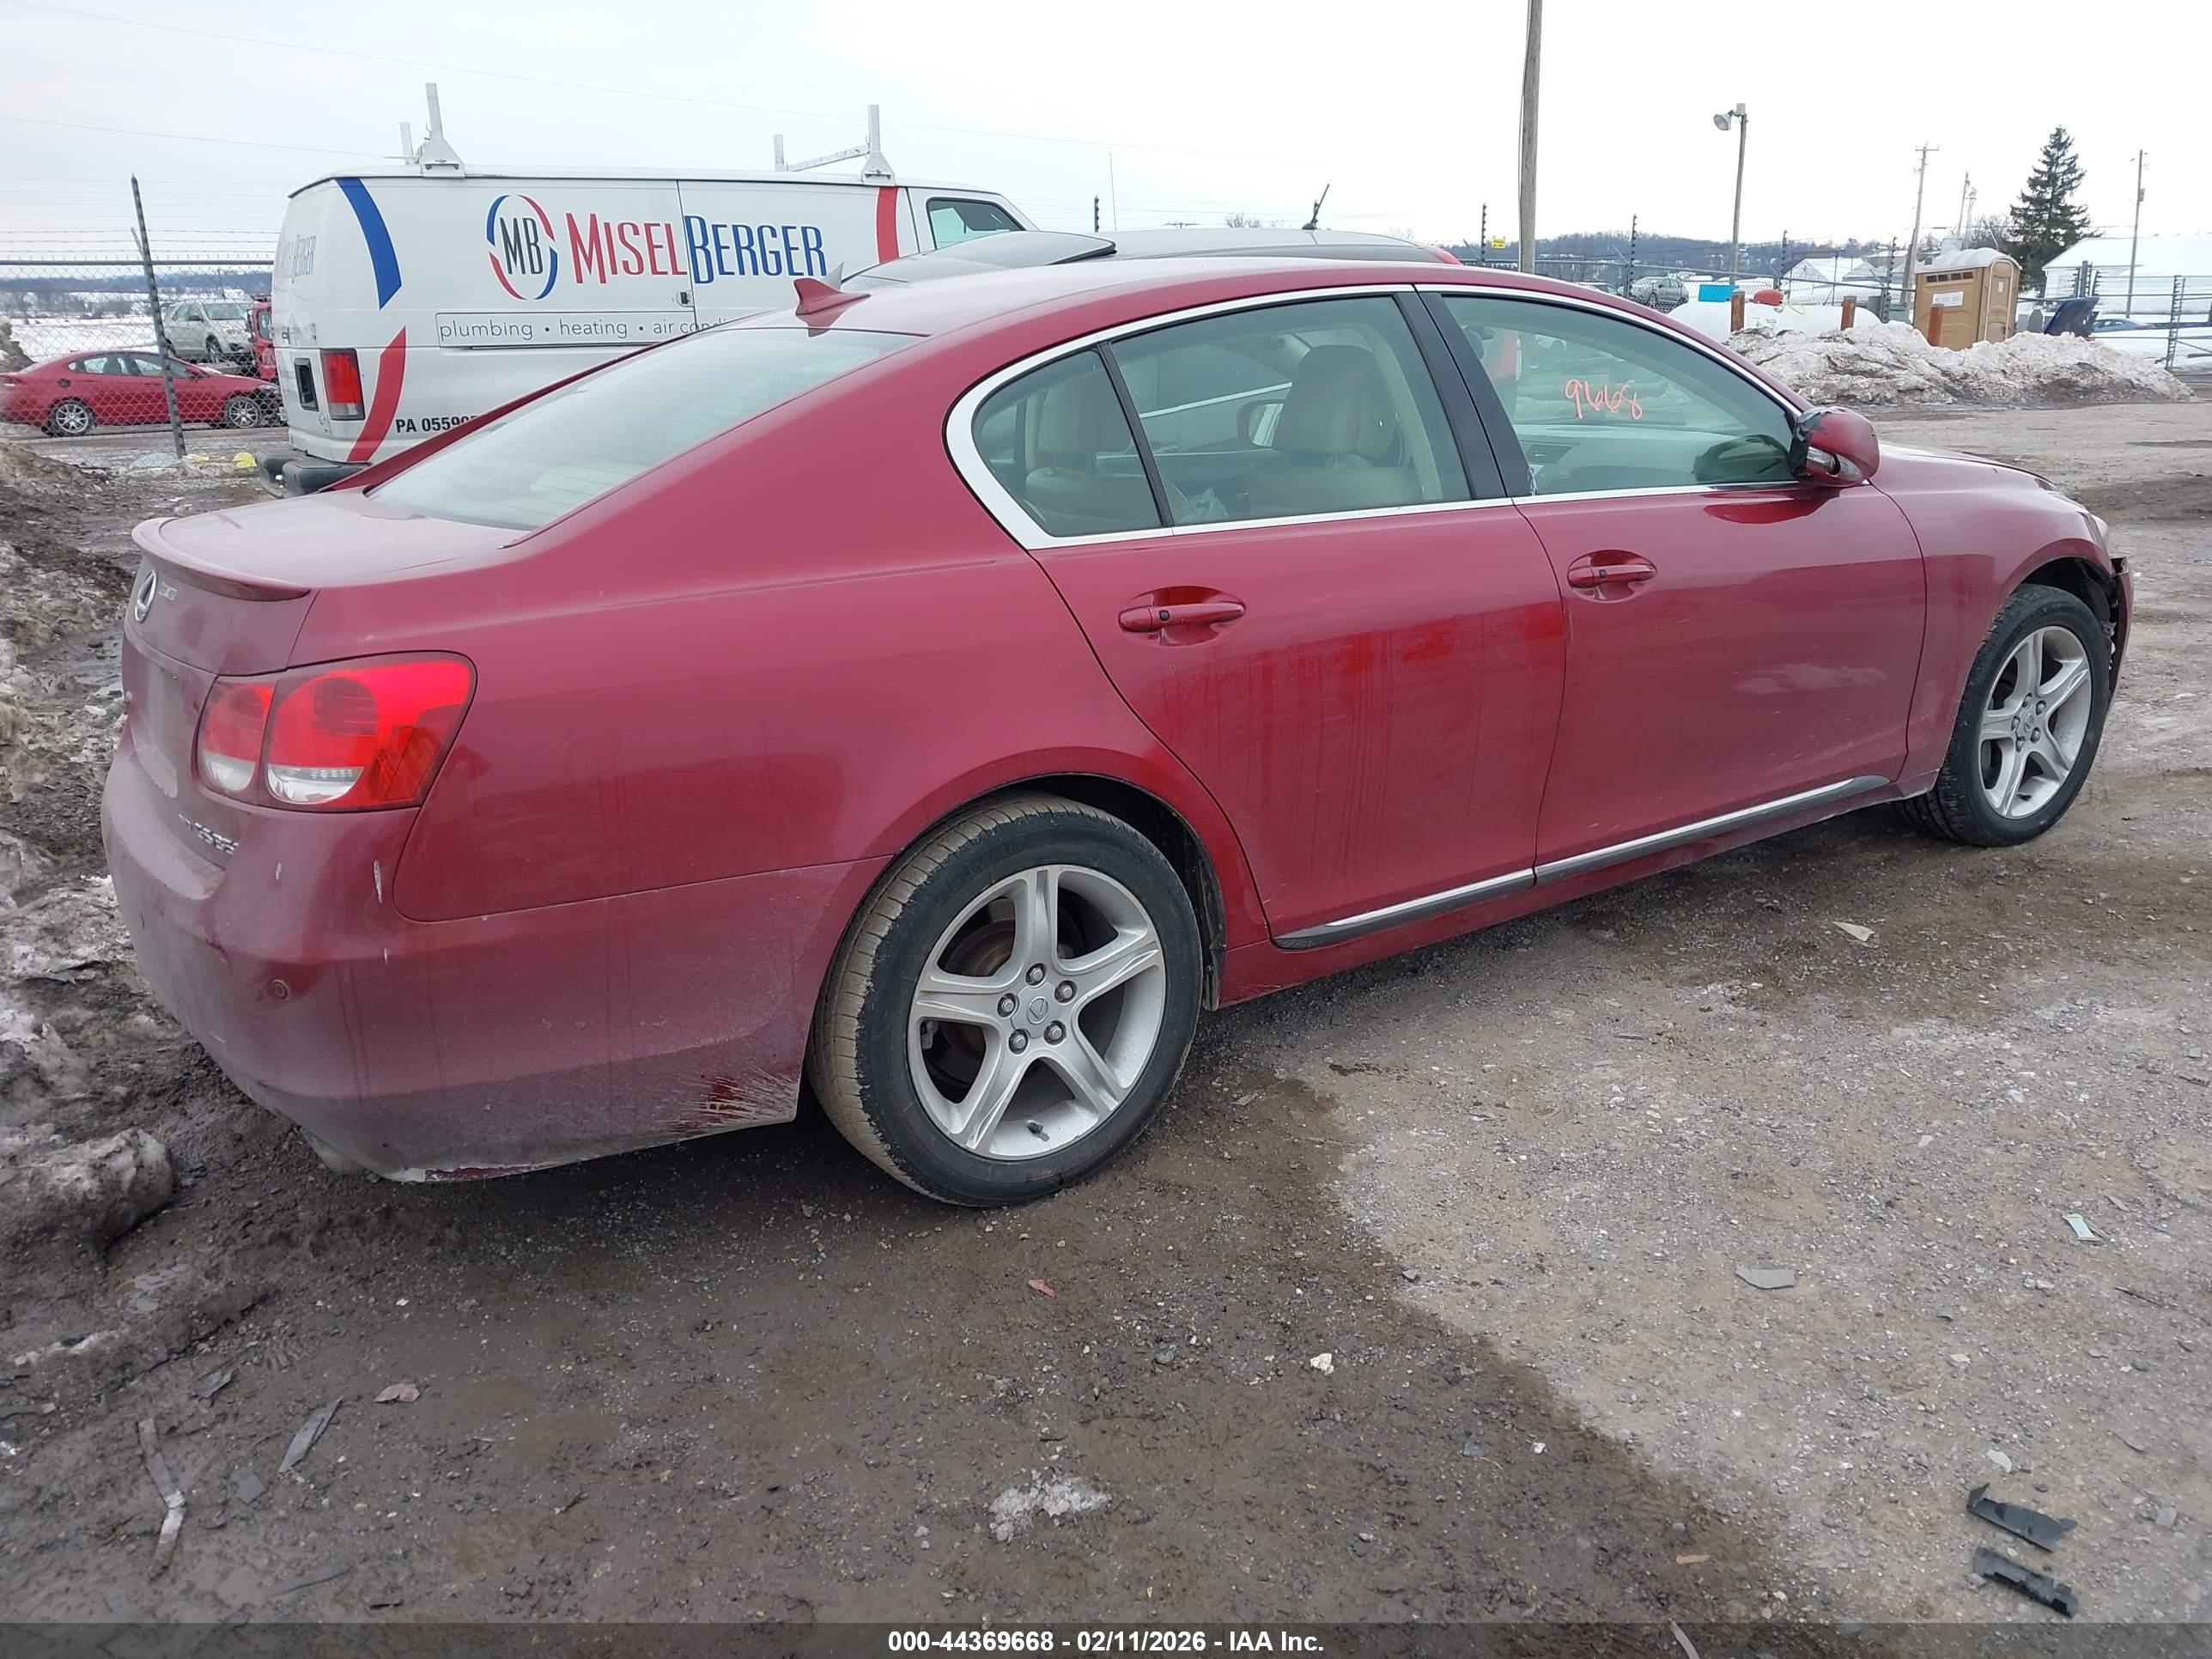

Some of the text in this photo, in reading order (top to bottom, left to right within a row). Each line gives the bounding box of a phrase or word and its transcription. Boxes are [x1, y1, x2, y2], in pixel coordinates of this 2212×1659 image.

[500, 217, 544, 275] MB
[440, 319, 533, 342] plumbing
[559, 318, 628, 339] heating
[653, 319, 674, 334] air
[1565, 379, 1644, 420] 9668
[395, 418, 417, 433] PA
